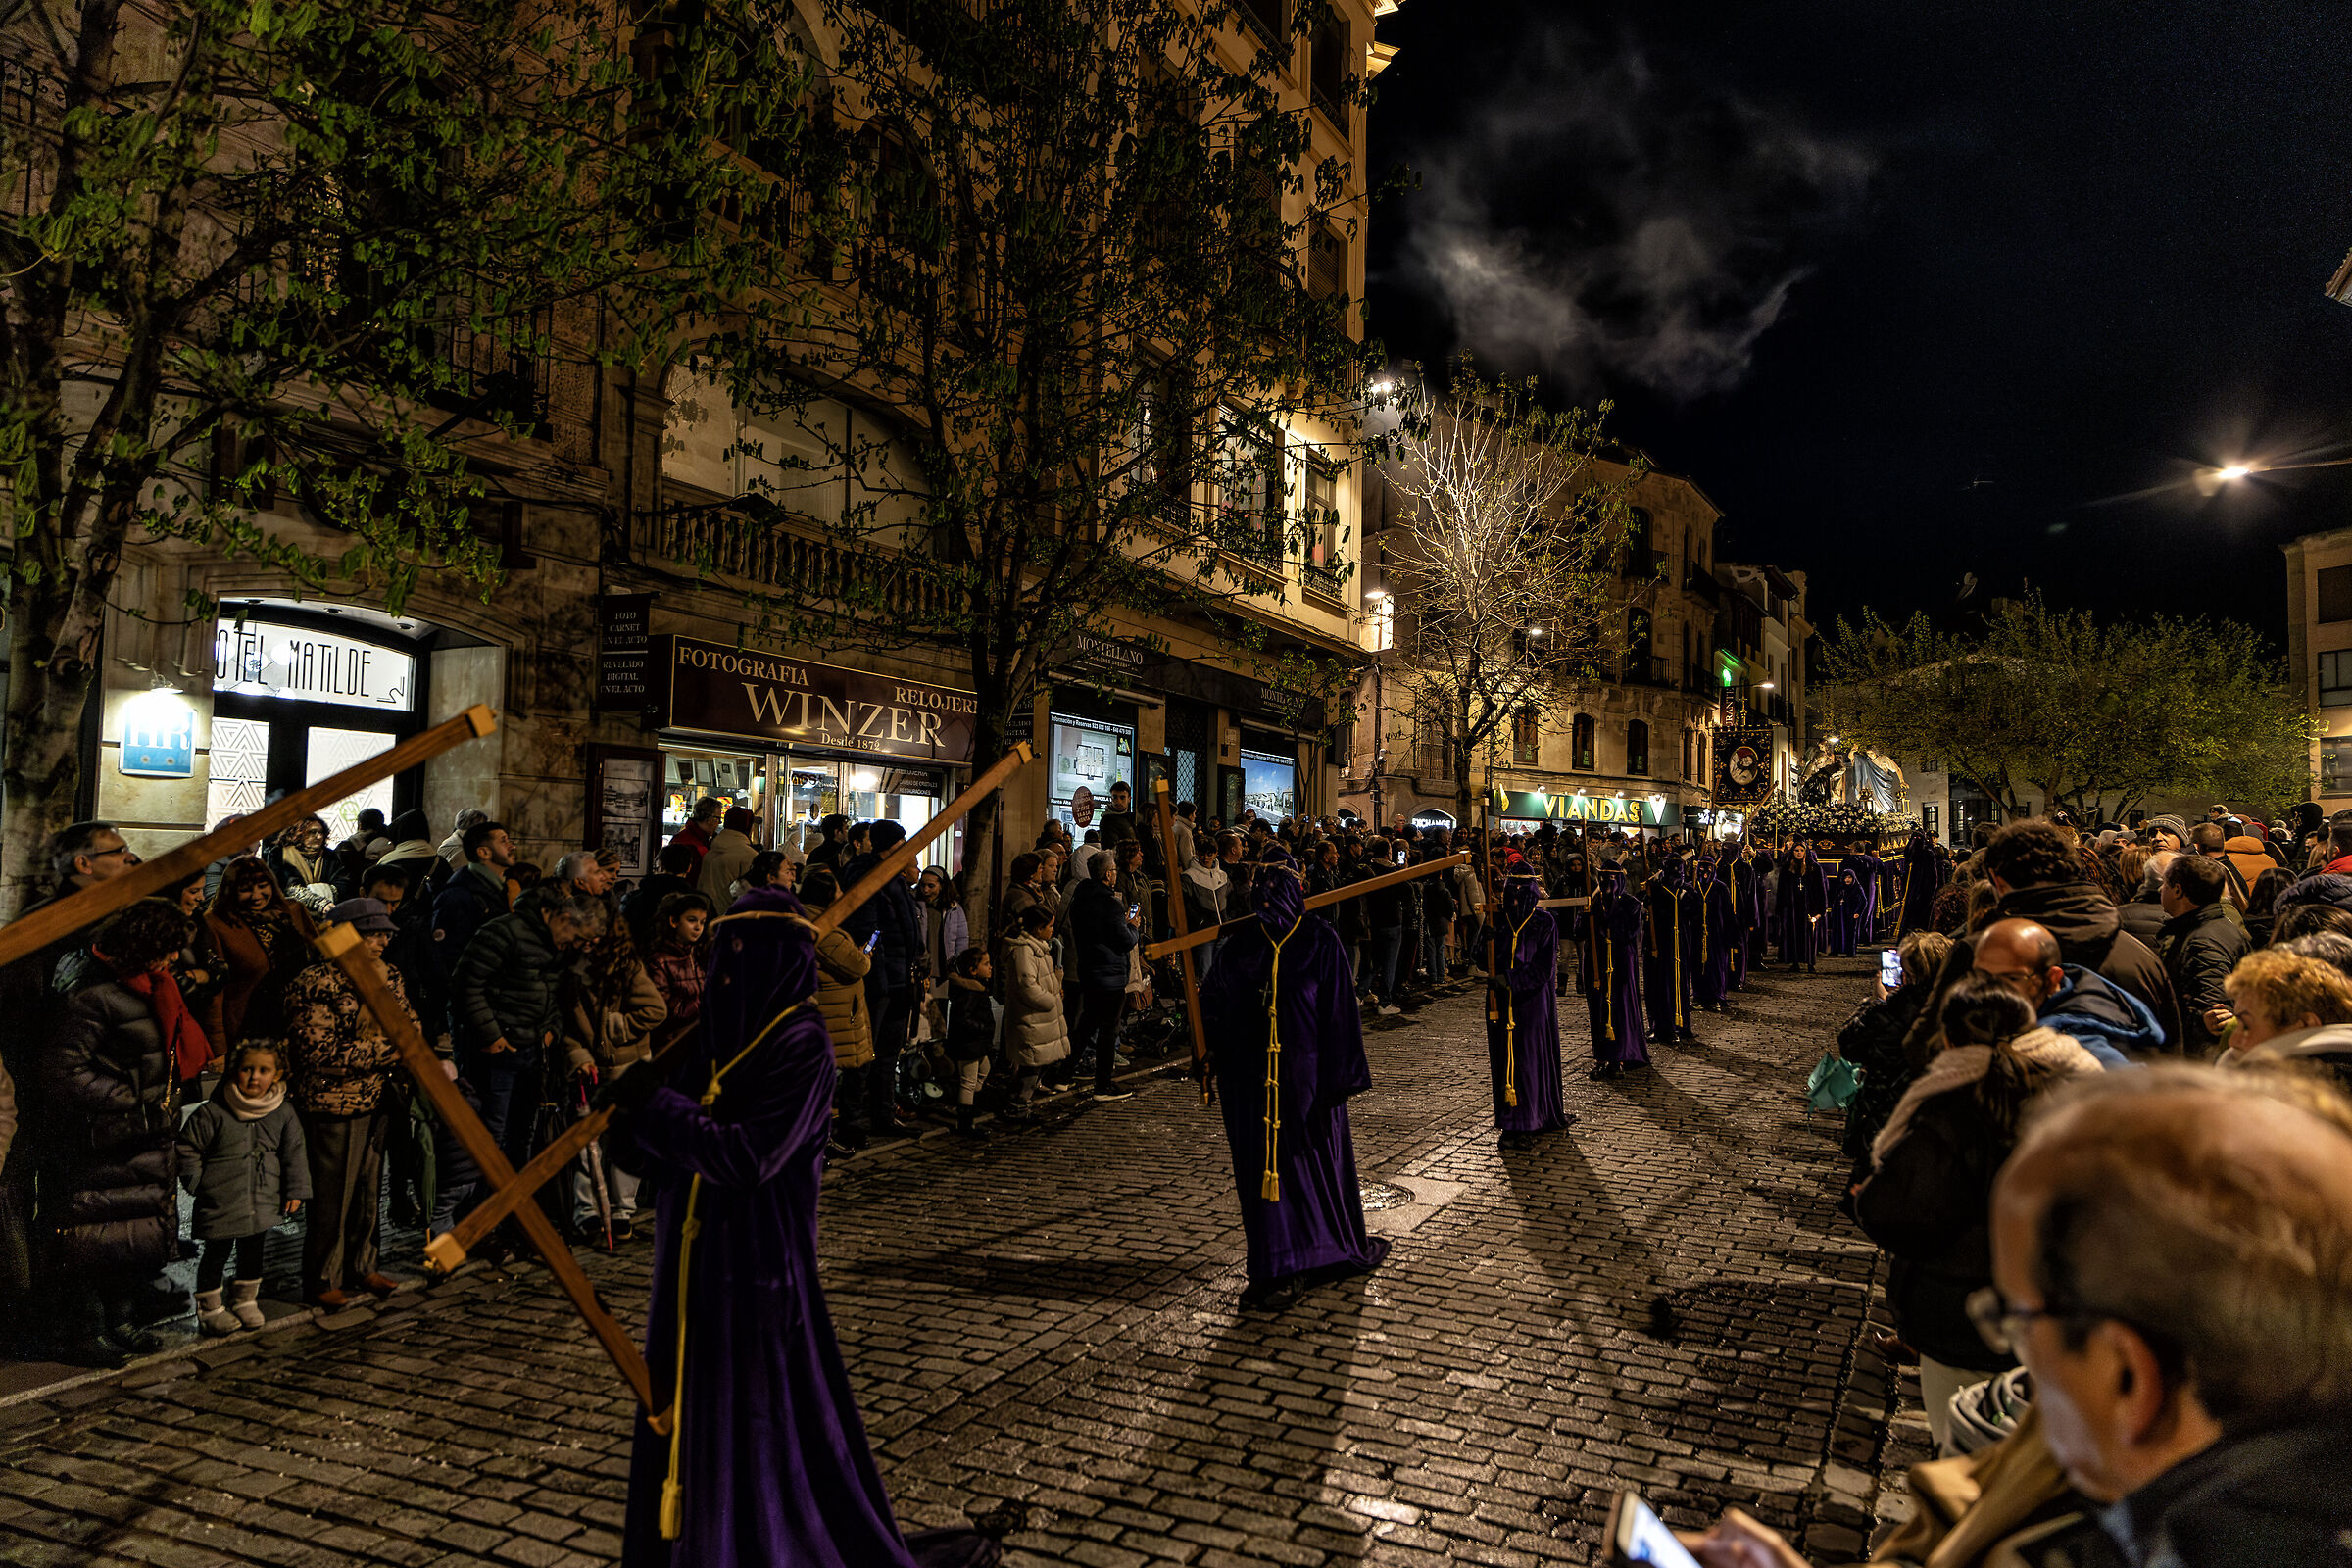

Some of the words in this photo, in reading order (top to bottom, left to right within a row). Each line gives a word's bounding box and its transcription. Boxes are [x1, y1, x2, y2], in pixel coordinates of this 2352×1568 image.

[614, 612, 637, 620] FOTO
[609, 623, 640, 632] CARNET
[625, 635, 648, 644] ACTO
[287, 640, 372, 698] MATILDE
[603, 661, 644, 669] REVELADO
[677, 647, 810, 687] FOTOGRAFIA
[607, 672, 639, 681] DIGITAL
[624, 684, 645, 693] ACTO
[895, 686, 978, 714] RELOJERI
[741, 682, 947, 748] WINZER
[858, 739, 880, 751] 1872
[1543, 794, 1641, 823] VIANDAS
